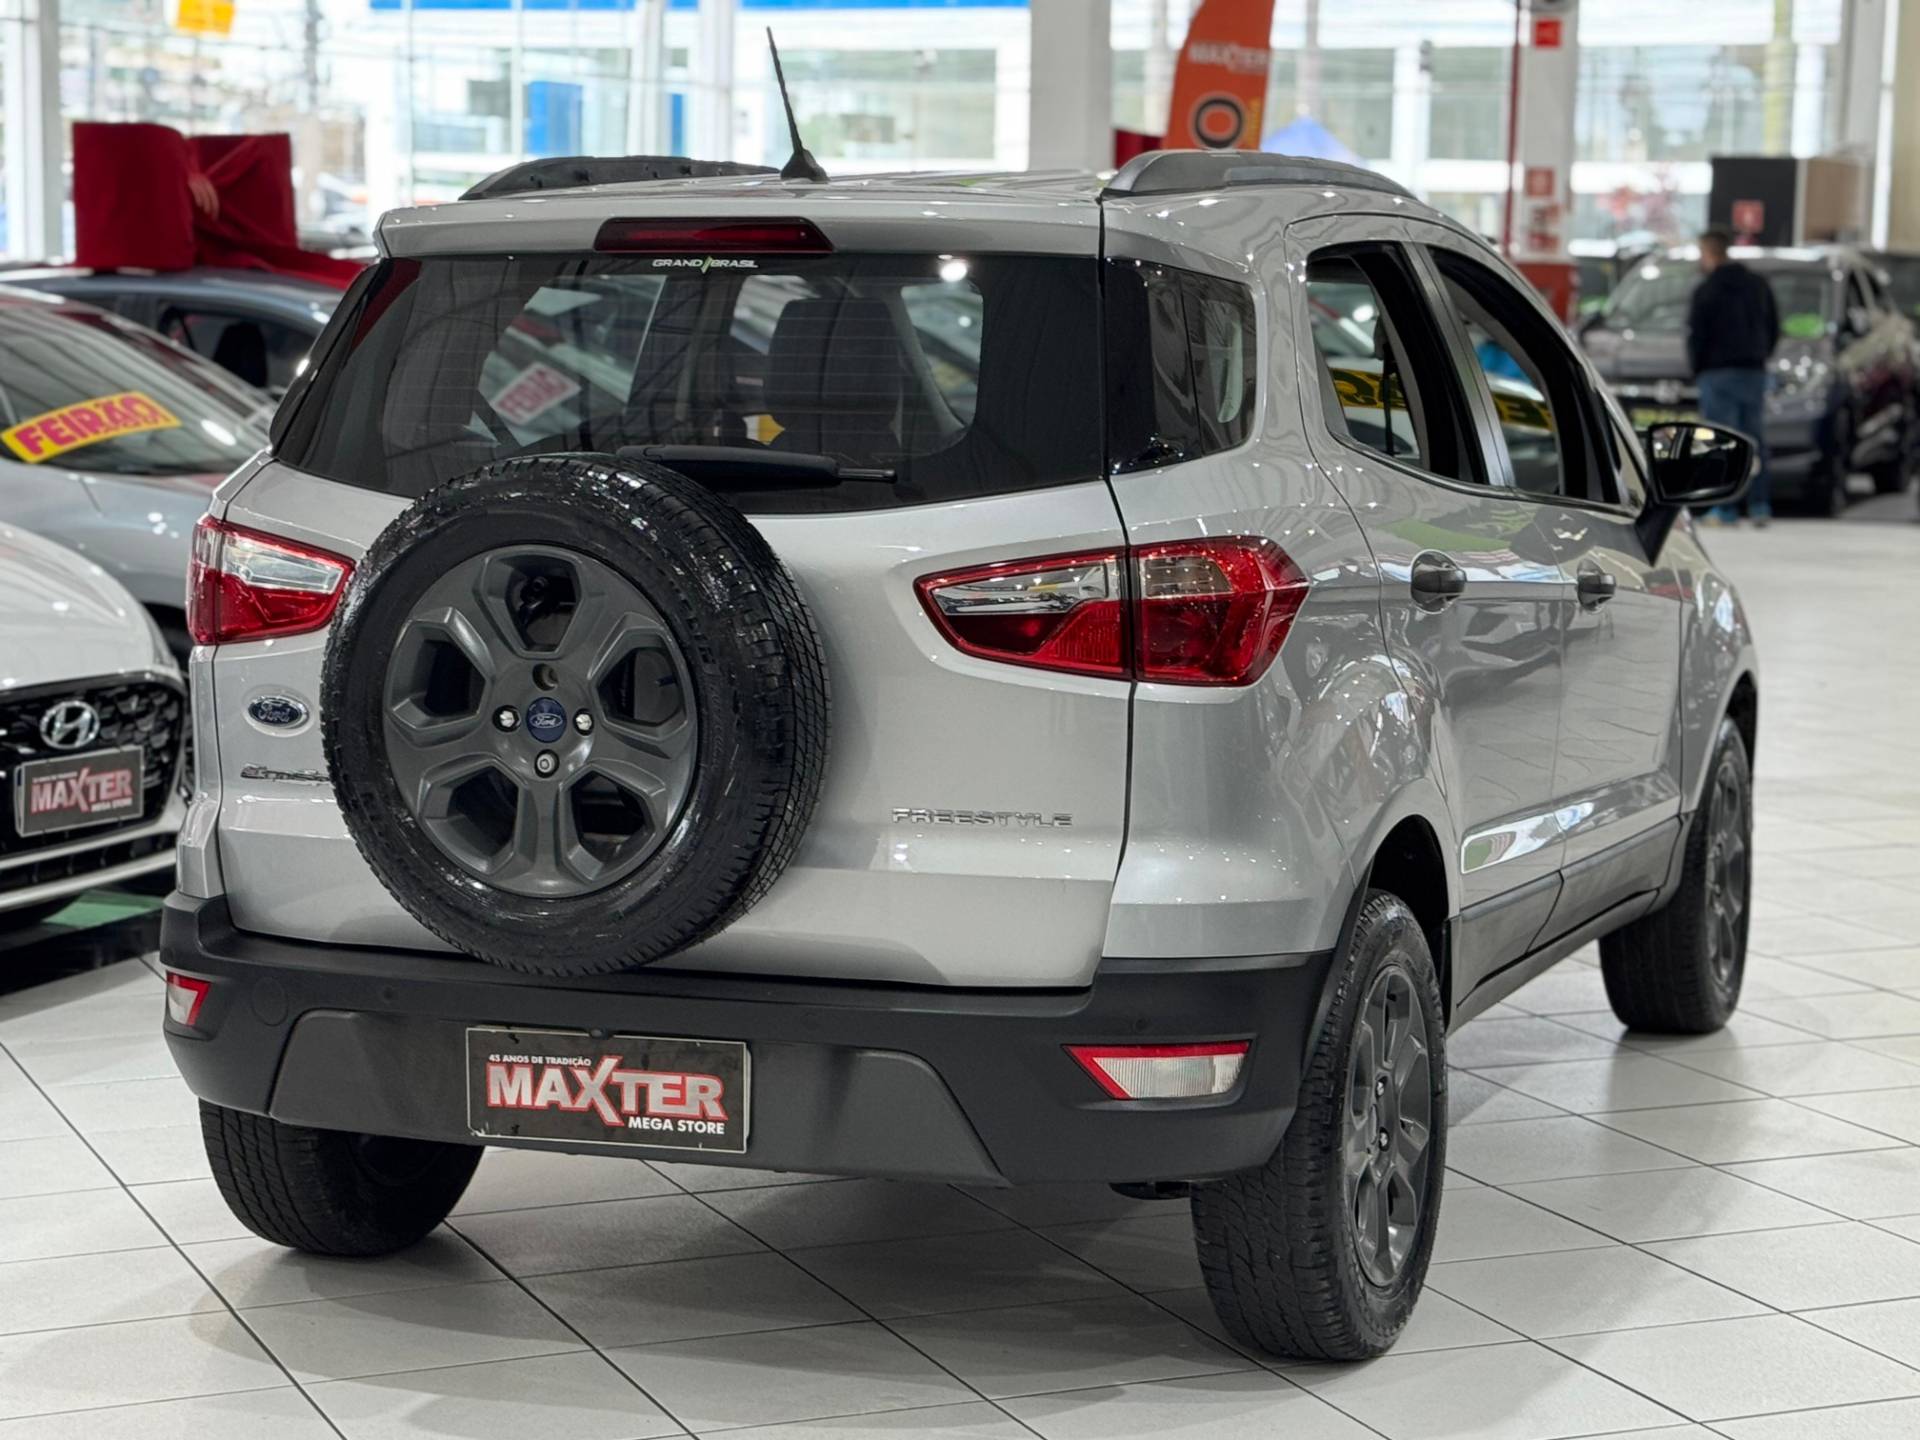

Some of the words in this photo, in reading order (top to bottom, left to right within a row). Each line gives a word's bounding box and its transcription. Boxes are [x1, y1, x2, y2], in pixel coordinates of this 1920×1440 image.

[652, 259, 703, 267] GRAND
[710, 259, 759, 268] BRASIL
[15, 394, 173, 456] FEIRÃO
[30, 765, 133, 815] MAXTER
[892, 807, 1073, 828] FREESTYLE
[502, 1055, 530, 1064] ANOS
[531, 1056, 544, 1064] DE
[545, 1055, 592, 1067] TRADIÇÃO
[486, 1055, 728, 1127] MAXTER
[628, 1116, 674, 1129] MEGA
[677, 1119, 725, 1135] STORE
